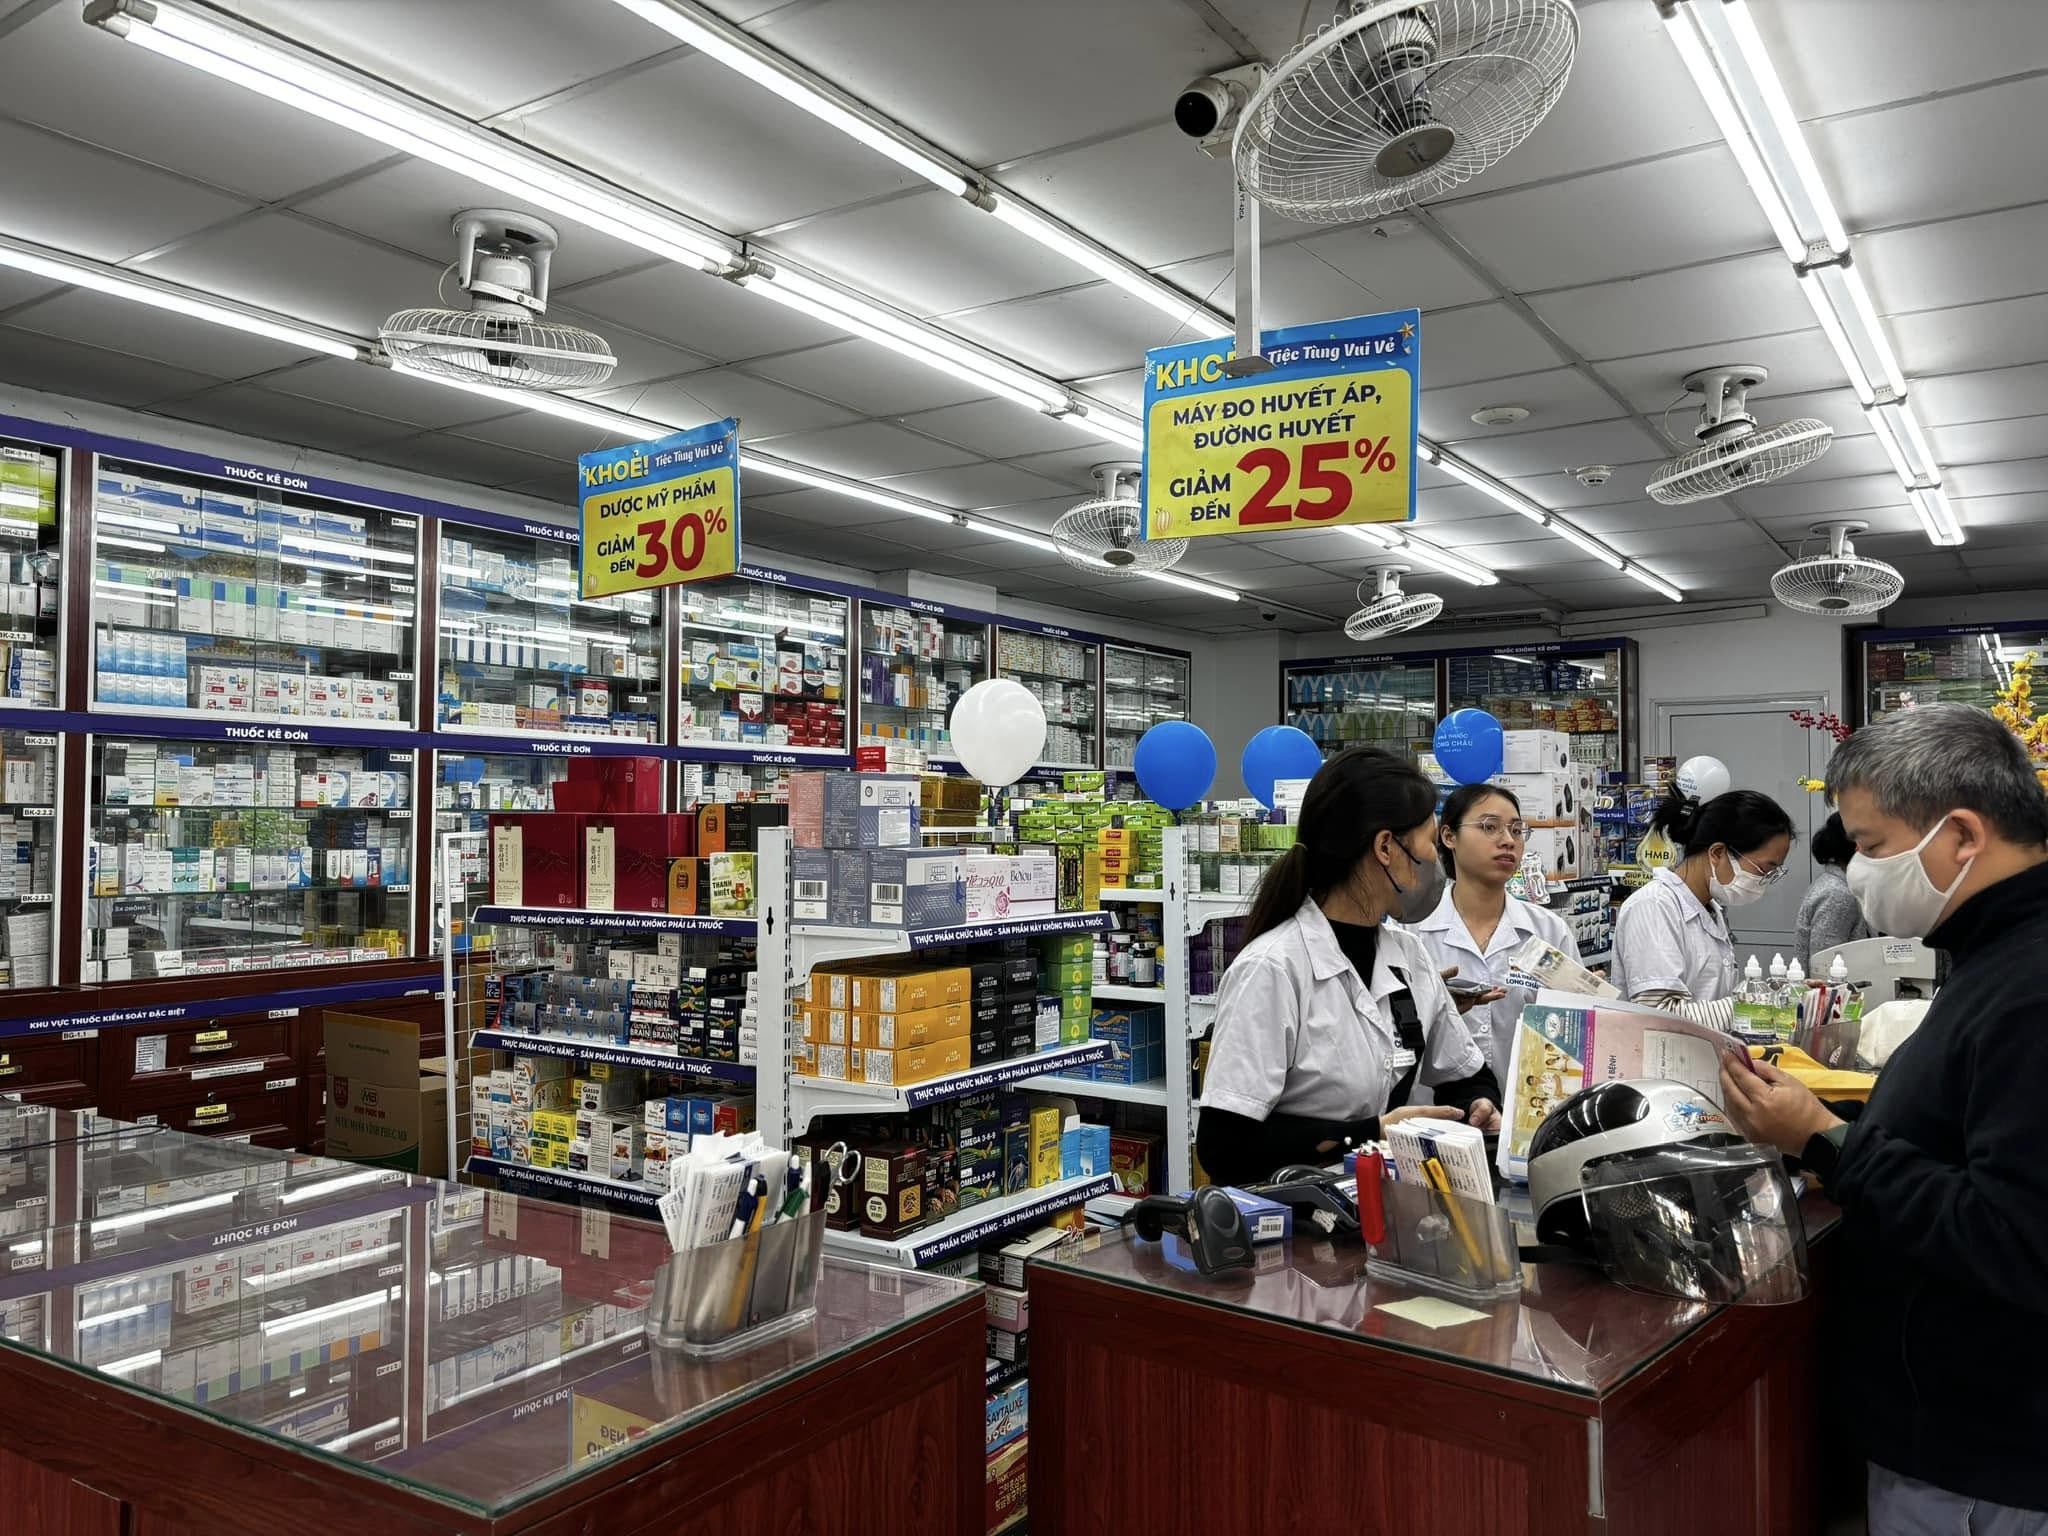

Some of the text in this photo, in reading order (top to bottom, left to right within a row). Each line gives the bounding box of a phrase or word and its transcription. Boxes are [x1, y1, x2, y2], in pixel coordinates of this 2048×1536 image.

[1268, 337, 1396, 365] Tiệc Tùng Vui Vẻ
[1174, 382, 1382, 426] MÁY ĐO HUYẾT ÁP,
[1194, 409, 1355, 449] ĐƯỜNG HUYẾT
[655, 441, 724, 467] Tiệc Tùng Vui Vẻ
[224, 466, 308, 489] THUỐC KÊ ĐƠN
[585, 450, 649, 488] KHOẺ!
[1169, 469, 1231, 498] GIẢM
[1236, 436, 1396, 526] 25%
[601, 477, 716, 518] DƯỢC MỸ PHẨM
[1190, 499, 1231, 522] ĐẾN
[524, 525, 552, 537] THUỐC
[553, 529, 565, 540] KÊ
[636, 506, 728, 578] 30%
[597, 534, 635, 557] GIẢM
[610, 555, 635, 573] ĐẾN
[743, 567, 787, 582] THUỐC KÊ ĐƠN
[25, 736, 54, 745] BK-2.2.1
[225, 727, 308, 740] THUỐC KÊ ĐƠN
[532, 743, 591, 754] THUỐC KÊ ĐƠN
[753, 754, 796, 764] THUỐC KÊ ĐƠN
[24, 808, 53, 816] BK-2.2.2
[1644, 849, 1670, 860] HMB
[712, 880, 732, 889] THANH
[713, 888, 730, 897] NHIỆT
[510, 914, 724, 930] THỰC PHẨM CHỨC NĂNG SẢN PHẨM NÀY KHÔNG PHẢI LÀ THUỐC
[914, 915, 1103, 945] THỰC PHẨM CHỨC NĂNG SẢN PHẨM NÀY KHÔNG PHẢI LÀ THUỐC
[1506, 978, 1524, 986] LONG
[654, 999, 669, 1008] BRAI
[30, 1007, 186, 1029] KHU VỰC THUỐC KIỂM SOÁT ĐẶC BIỆT
[501, 1040, 711, 1074] THỰC PHẨM CHỨC NĂNG SẢN PHẨM NÀY KHÔNG PHẢI LÀ THUỐC
[914, 1050, 1104, 1100] THỰC PHẨM CHỨC NĂNG SẢN PHẨM NÀY KHÔNG PHẢI LÀ THUỐC
[960, 1137, 980, 1149] OMEGA
[499, 1168, 654, 1205] THỰC PHẨM CHỨC NĂNG SẢN PHẨM NÀY KHÔNG
[960, 1175, 980, 1188] OMEGA
[919, 1182, 1110, 1260] THỰC PHẨM CHỨC NĂNG SẢN PHẨM NÀY KHÔNG PHẢI LÀ THUỐC
